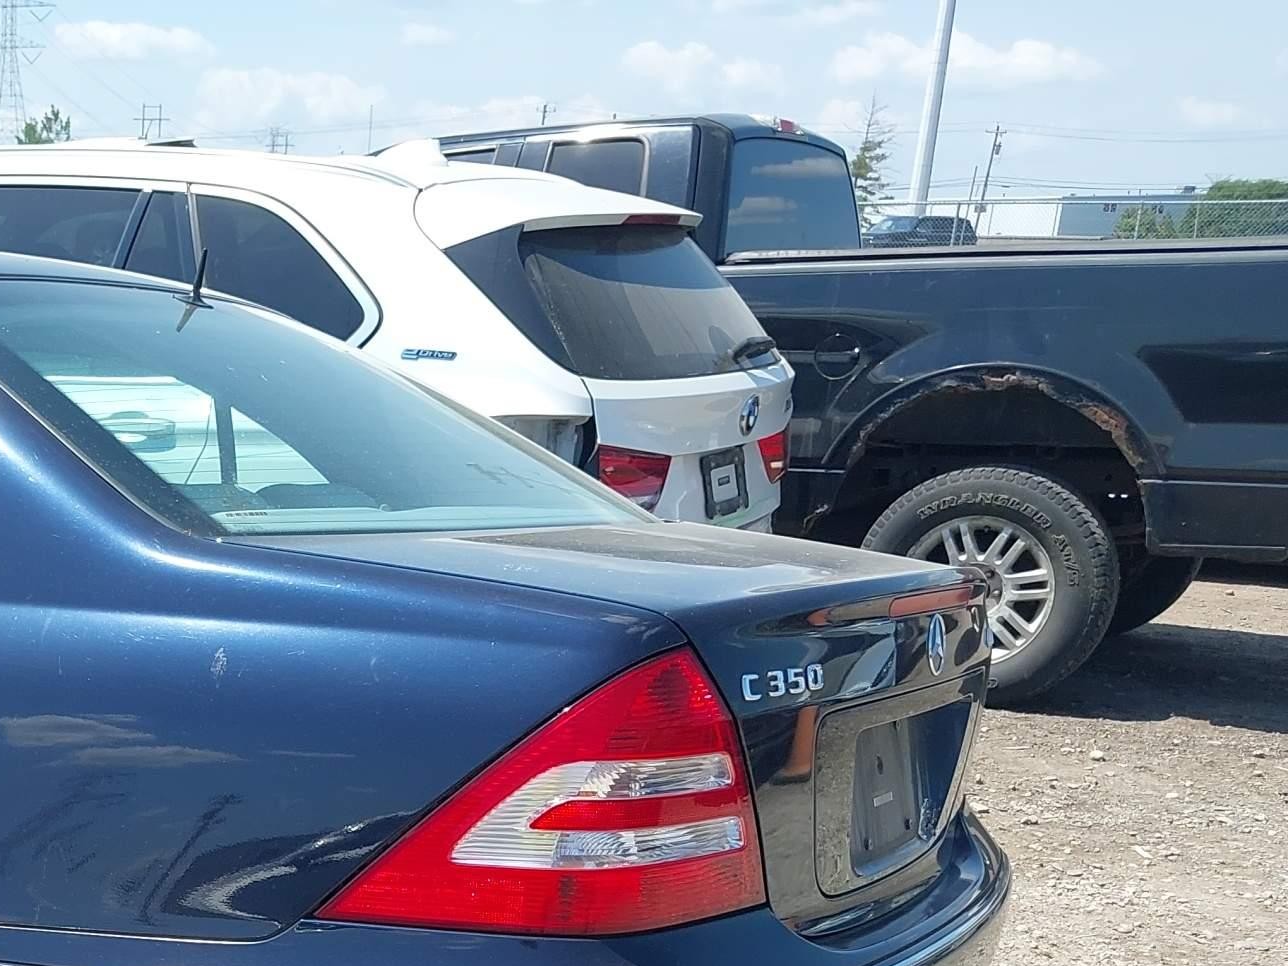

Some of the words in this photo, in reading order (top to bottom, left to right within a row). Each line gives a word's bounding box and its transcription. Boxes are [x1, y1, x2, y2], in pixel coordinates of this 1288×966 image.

[916, 492, 1053, 529] WRANGLER
[741, 673, 763, 701] C
[766, 663, 825, 697] 350
